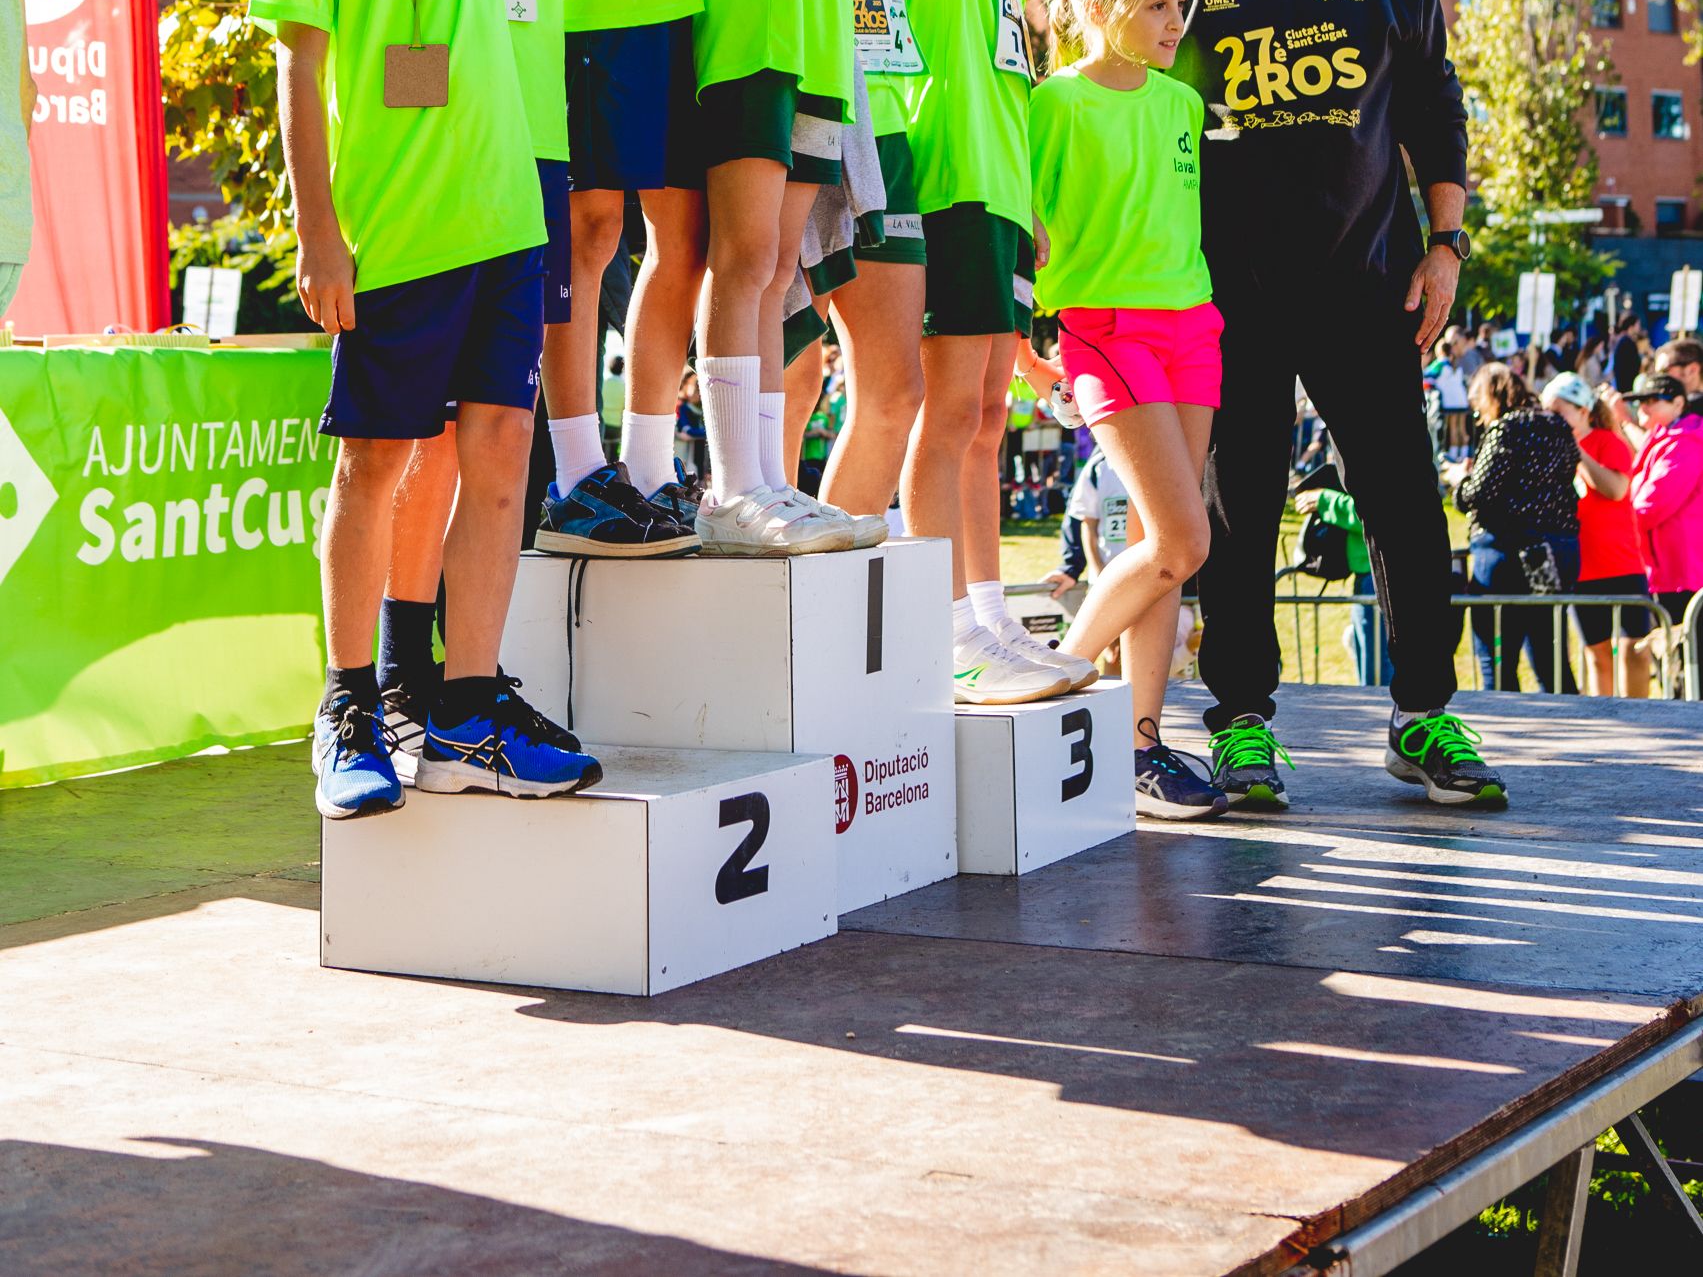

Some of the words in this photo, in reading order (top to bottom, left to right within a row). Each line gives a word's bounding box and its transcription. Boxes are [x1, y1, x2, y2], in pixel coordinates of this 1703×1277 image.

[1285, 25, 1319, 40] Ciutat
[1320, 22, 1335, 32] de
[1286, 36, 1314, 49] Sant
[1314, 28, 1348, 43] Cugat
[1224, 47, 1367, 111] CROS
[893, 219, 903, 229] LA
[76, 477, 330, 566] SantCug
[864, 745, 929, 785] Diputació
[1061, 707, 1094, 803] 3
[865, 782, 929, 815] Barcelona
[715, 791, 771, 905] 2
